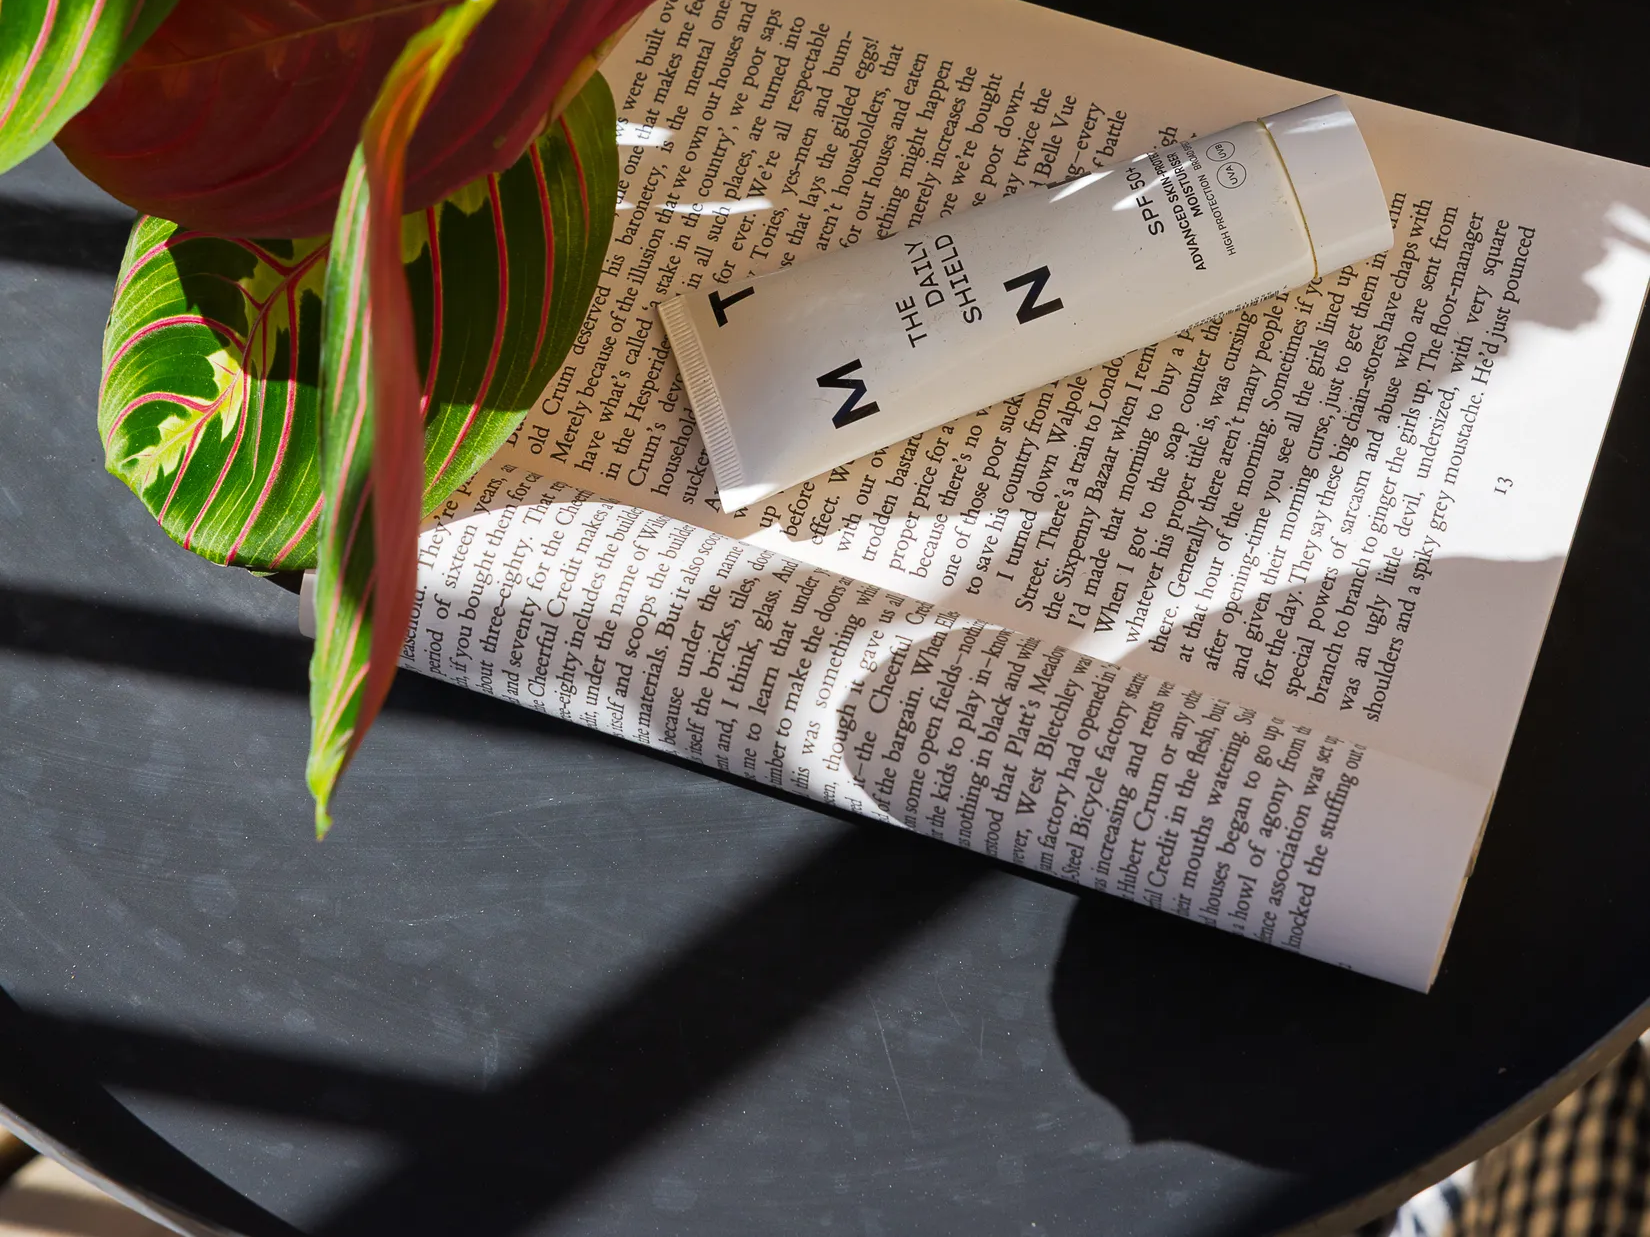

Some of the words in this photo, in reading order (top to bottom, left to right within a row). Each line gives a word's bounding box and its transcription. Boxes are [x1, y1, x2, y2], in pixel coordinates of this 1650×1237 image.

[736, 0, 757, 33] and
[683, 38, 715, 96] mental
[707, 35, 744, 90] houses
[821, 30, 852, 77] bum-
[665, 104, 688, 130] the
[701, 91, 721, 121] our
[812, 85, 833, 117] and
[830, 87, 891, 198] householders,
[878, 43, 904, 76] that
[655, 140, 674, 154] is
[684, 125, 709, 161] own
[785, 212, 811, 245] that
[798, 175, 827, 207] lays
[815, 143, 838, 169] the
[831, 84, 860, 139] gilded
[854, 36, 879, 79] eggs!
[1032, 134, 1062, 179] Belle
[1049, 94, 1077, 128] Vue
[1214, 143, 1226, 159] UVB
[672, 162, 691, 188] we
[780, 127, 818, 196] yes-men
[1125, 162, 1145, 190] 50+
[1185, 149, 1202, 171] BROAD
[1225, 164, 1238, 185] UVA
[613, 164, 668, 245] baronetcy,
[1166, 151, 1203, 217] MOISTURISER
[1197, 173, 1226, 230] PROTECTION
[654, 192, 680, 224] that
[1135, 195, 1164, 235] SPF
[1409, 199, 1433, 237] with
[1428, 206, 1458, 251] from
[748, 207, 789, 259] Tories,
[1172, 204, 1206, 270] ADVANCED
[1220, 230, 1236, 256] HIGH
[1482, 219, 1509, 276] square
[601, 251, 626, 278] his
[625, 228, 665, 285] illusion
[903, 241, 945, 308] DAILY
[1336, 264, 1358, 286] up
[1389, 241, 1420, 289] chaps
[1420, 256, 1441, 291] sent
[1429, 211, 1484, 337] floor-manager
[1501, 225, 1536, 304] pounced
[615, 286, 638, 312] the
[934, 234, 982, 323] SHIELD
[1002, 265, 1063, 324] N
[570, 283, 612, 357] deserved
[609, 309, 627, 334] of
[707, 275, 755, 327] T
[894, 295, 927, 348] THE
[1314, 290, 1345, 335] lined
[1372, 290, 1402, 333] have
[1410, 297, 1428, 324] are
[1465, 284, 1493, 323] very
[1485, 305, 1511, 343] just
[575, 335, 619, 398] because
[1305, 339, 1329, 377] girls
[1393, 331, 1417, 368] who
[1416, 338, 1445, 371] The
[1450, 335, 1474, 373] with
[541, 363, 577, 415] Crum
[816, 358, 880, 429] M
[1124, 381, 1143, 392] I
[1291, 379, 1314, 409] the
[1341, 333, 1388, 431] chain-stores
[1373, 376, 1402, 424] abuse
[1411, 379, 1433, 404] up.
[1045, 372, 1087, 444] Walpole
[1110, 395, 1138, 441] when
[1283, 409, 1304, 432] all
[1399, 407, 1420, 445] girls
[527, 424, 550, 454] old
[549, 399, 592, 464] Merely
[1276, 434, 1295, 463] see
[1328, 432, 1359, 462] big
[1364, 428, 1384, 462] and
[1416, 386, 1460, 478] undersized,
[1443, 392, 1484, 485] moustache.
[1026, 454, 1059, 505] down
[1083, 445, 1119, 503] Bazaar
[1385, 446, 1407, 473] the
[1263, 468, 1285, 503] you
[1315, 464, 1343, 506] these
[1340, 470, 1371, 534] sarcasm
[1367, 476, 1397, 534] ginger
[1493, 476, 1513, 495] 13
[1310, 509, 1332, 537] say
[1393, 492, 1425, 537] devil,
[1429, 489, 1455, 532] grey
[441, 524, 477, 588] sixteen
[1004, 507, 1037, 565] turned
[1052, 504, 1103, 587] Sixpenny
[1329, 535, 1347, 559] of
[1360, 536, 1377, 553] to
[1412, 534, 1440, 580] spiky
[995, 570, 1014, 581] I
[1221, 507, 1271, 624] opening-time
[1287, 538, 1322, 583] They
[1374, 546, 1403, 585] little
[433, 592, 451, 619] of
[728, 577, 760, 609] tiles,
[1041, 590, 1065, 619] the
[1274, 590, 1304, 626] day.
[1306, 566, 1338, 632] powers
[1334, 558, 1371, 616] branch
[1407, 585, 1421, 595] a
[527, 621, 559, 697] Cheerful
[546, 557, 582, 618] Credit
[614, 661, 633, 698] and
[624, 594, 657, 658] scoops
[646, 563, 669, 589] the
[751, 589, 782, 631] glass.
[1332, 619, 1350, 638] to
[1364, 593, 1392, 635] ugly
[1395, 597, 1416, 633] and
[699, 618, 741, 679] bricks,
[1203, 628, 1229, 671] after
[1264, 628, 1288, 656] the
[1354, 646, 1372, 668] an
[726, 638, 763, 693] think,
[1253, 658, 1278, 688] for
[1285, 635, 1315, 697] special
[1305, 642, 1343, 704] branch
[1362, 636, 1404, 722] shoulders
[690, 686, 713, 717] the
[720, 697, 739, 709] I
[821, 703, 857, 771] though
[850, 679, 865, 695] it
[859, 629, 884, 673] gave
[878, 608, 895, 623] us
[1339, 677, 1361, 711] was
[1014, 766, 1047, 815] West
[1033, 678, 1084, 761] Bletchley
[990, 763, 1017, 802] that
[1132, 771, 1169, 832] Crum
[1160, 743, 1178, 765] or
[1169, 711, 1195, 740] any
[1214, 796, 1252, 855] began
[1242, 770, 1261, 789] to
[1253, 744, 1273, 767] go
[1227, 873, 1257, 921] howl
[1247, 838, 1266, 867] of
[1258, 776, 1293, 838] agony
[1276, 737, 1306, 772] from
[1268, 803, 1311, 906] association
[1302, 765, 1325, 795] was
[1282, 881, 1316, 949] knocked
[1302, 844, 1328, 876] the
[1319, 771, 1359, 839] stuffing
